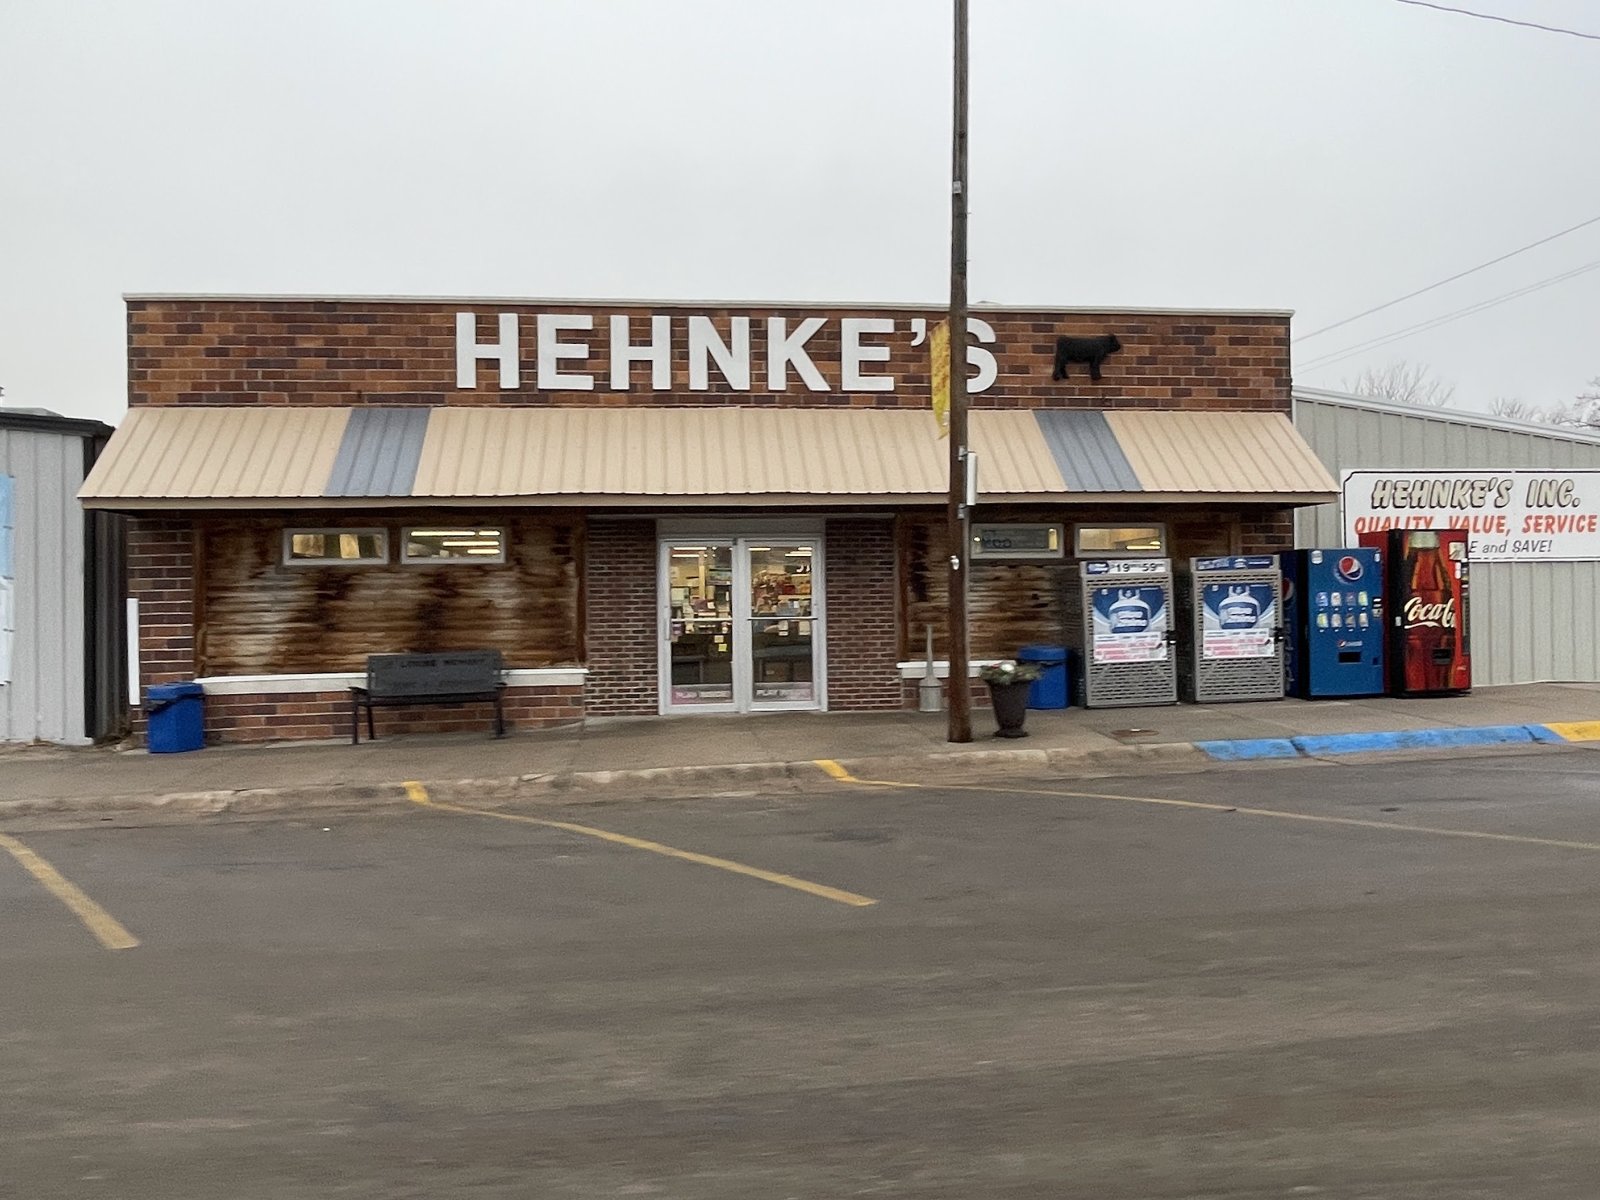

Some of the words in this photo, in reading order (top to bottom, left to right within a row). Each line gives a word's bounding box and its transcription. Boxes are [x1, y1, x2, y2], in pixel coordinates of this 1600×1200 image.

[455, 312, 997, 393] HEHNKE'S
[1371, 479, 1513, 509] HEHNKE'S
[1526, 479, 1580, 508] INC.
[1449, 515, 1510, 536] VALUE,
[1522, 515, 1597, 533] SERVICE
[1482, 540, 1508, 553] and
[1512, 540, 1552, 553] SAVE!
